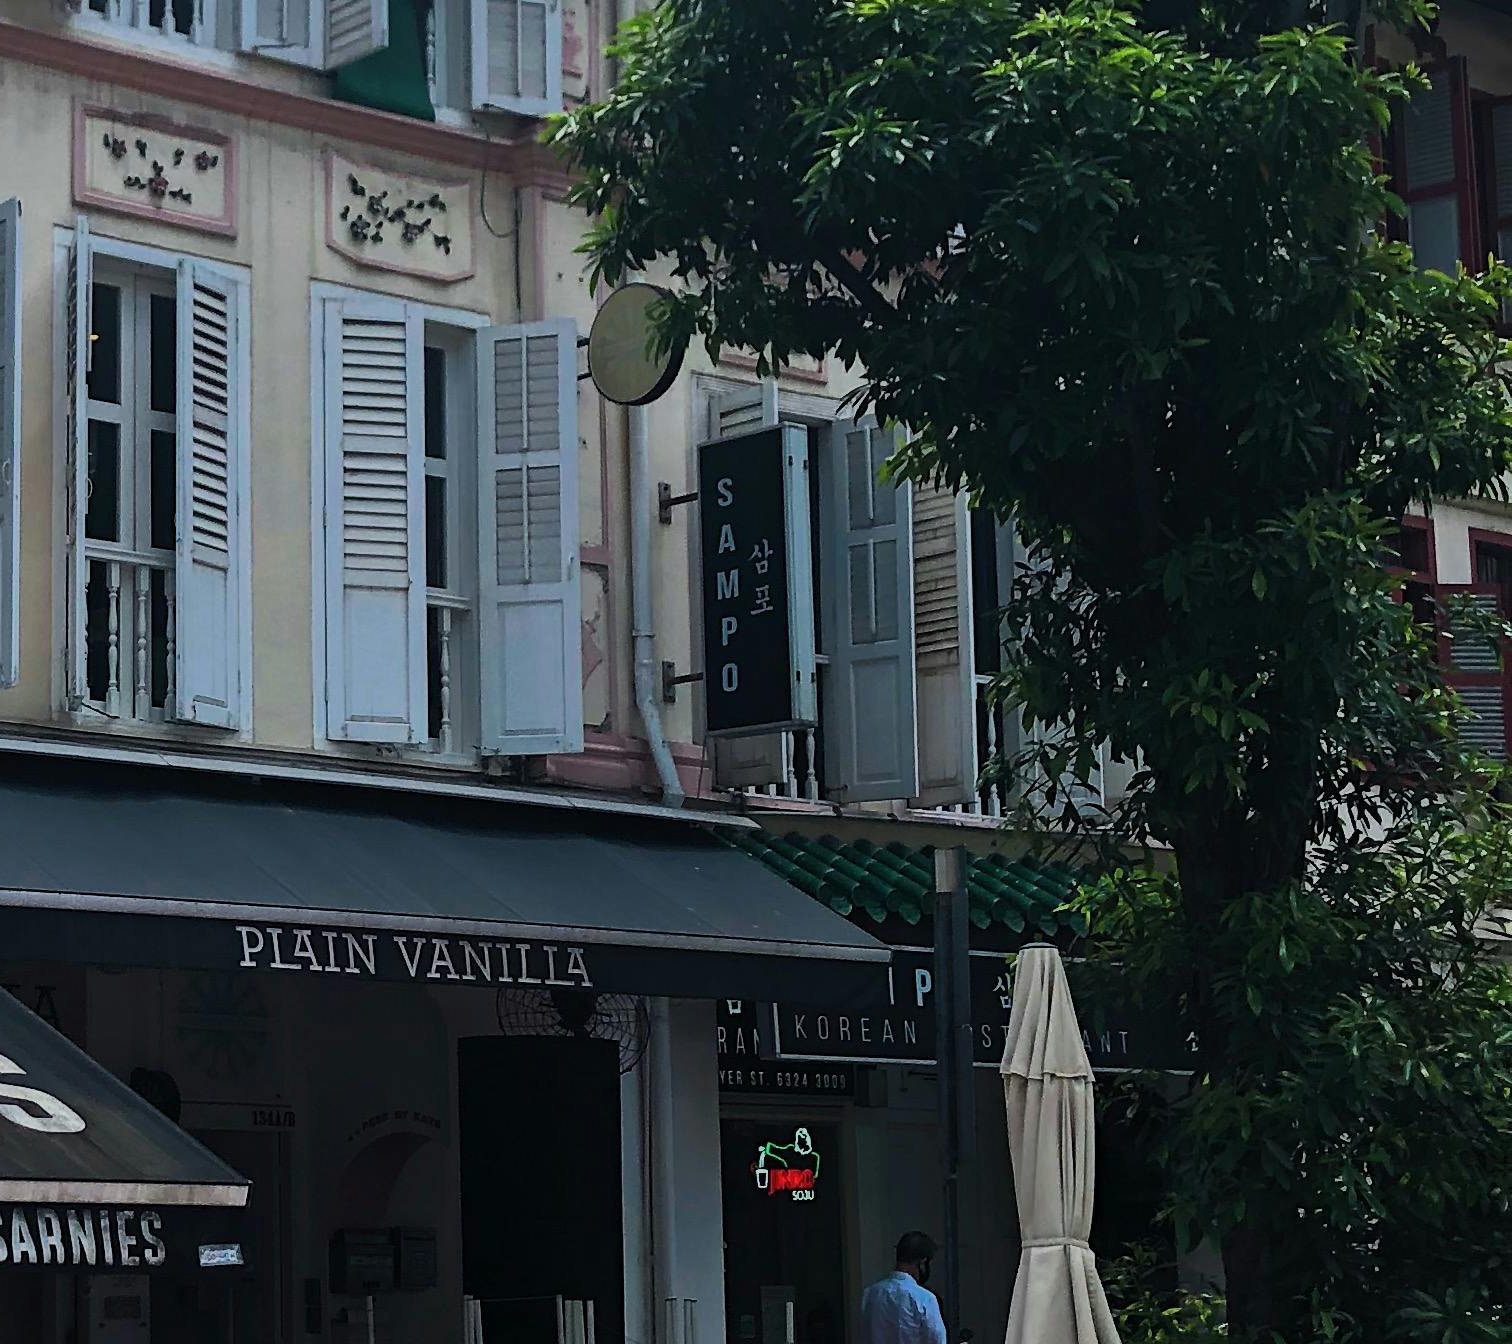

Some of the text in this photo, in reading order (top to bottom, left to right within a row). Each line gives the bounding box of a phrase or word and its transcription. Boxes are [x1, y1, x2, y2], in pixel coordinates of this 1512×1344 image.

[715, 476, 740, 694] SAMPO
[747, 538, 775, 616] 삼포
[235, 925, 594, 988] PLAIN VANILLA
[794, 1013, 919, 1045] KOREAN
[719, 1070, 743, 1085] YER
[777, 1072, 808, 1088] 6324
[791, 1189, 815, 1201] SOJU
